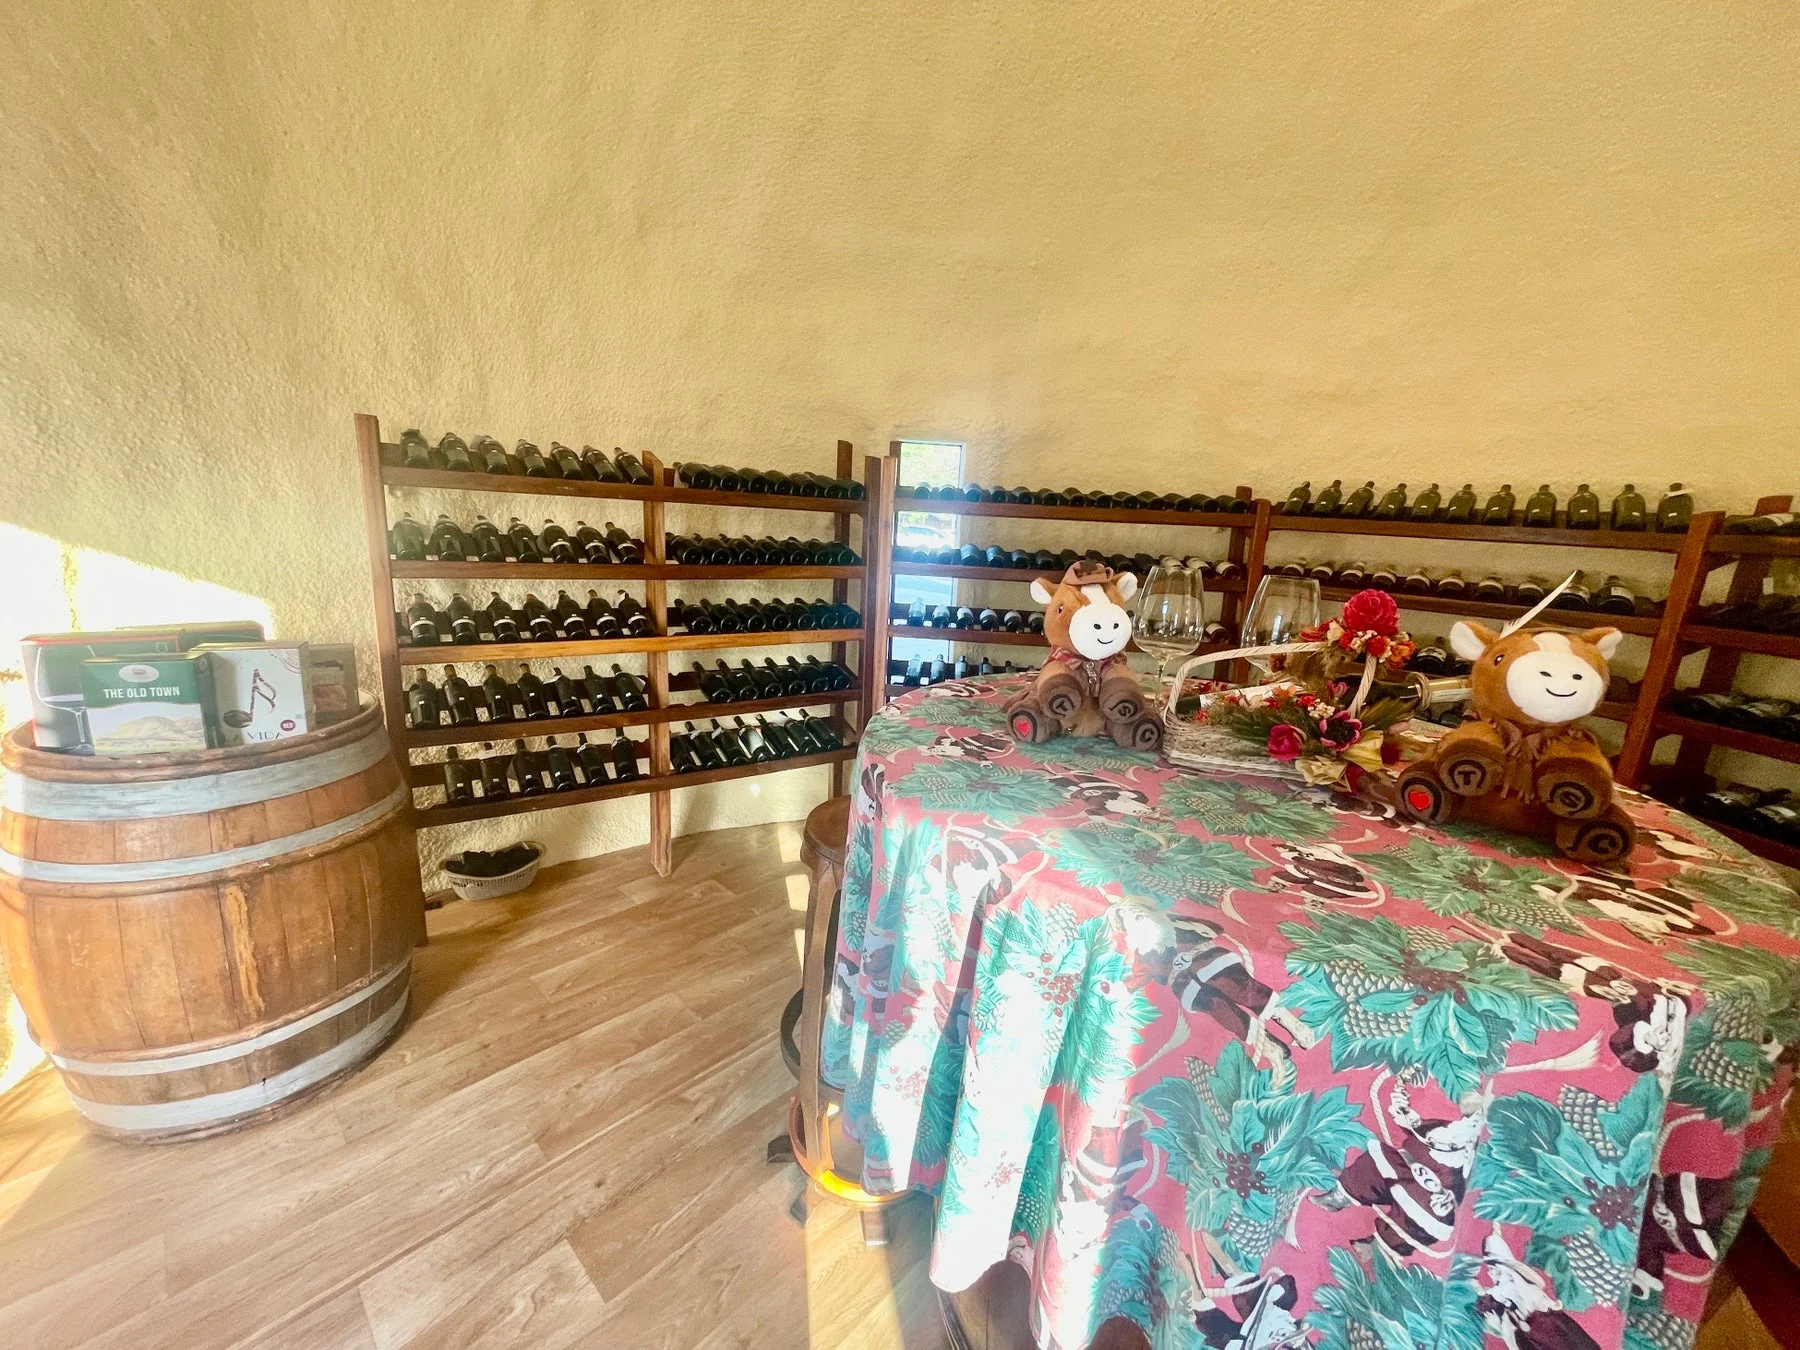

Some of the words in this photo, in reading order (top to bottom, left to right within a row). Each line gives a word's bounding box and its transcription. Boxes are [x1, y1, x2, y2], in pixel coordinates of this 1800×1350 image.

[103, 688, 125, 699] THE
[127, 687, 148, 698] OLD
[149, 686, 181, 697] TOWN
[1055, 700, 1069, 713] T
[1118, 705, 1131, 717] S
[1457, 770, 1477, 786] T
[1559, 790, 1583, 808] S
